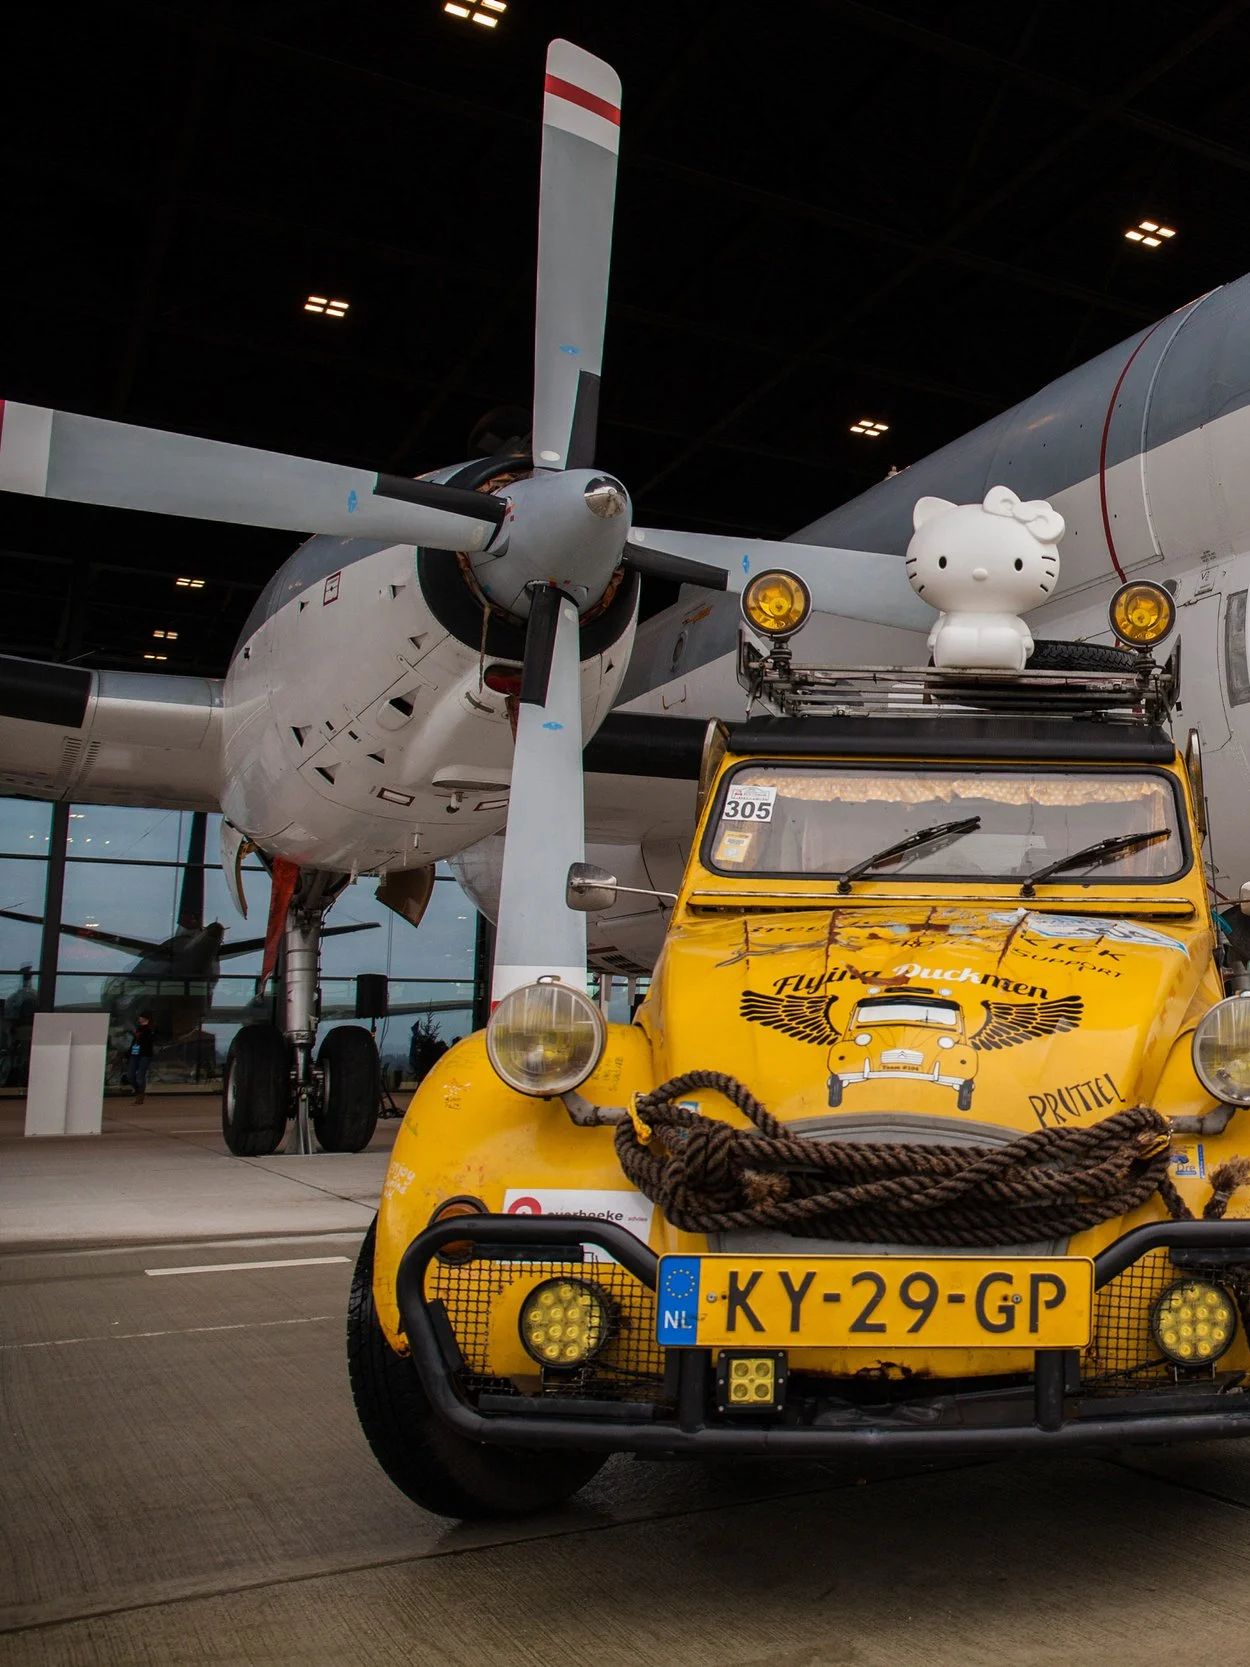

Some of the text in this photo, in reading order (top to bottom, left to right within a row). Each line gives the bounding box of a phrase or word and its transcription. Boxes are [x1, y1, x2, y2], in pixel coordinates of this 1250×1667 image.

[724, 800, 772, 819] 305
[1010, 942, 1124, 978] SUPPORT
[893, 962, 1049, 1000] Duckmen
[1028, 1073, 1126, 1129] PRUTTEL
[664, 1310, 692, 1329] NL
[725, 1271, 1067, 1334] KY-29-GP
